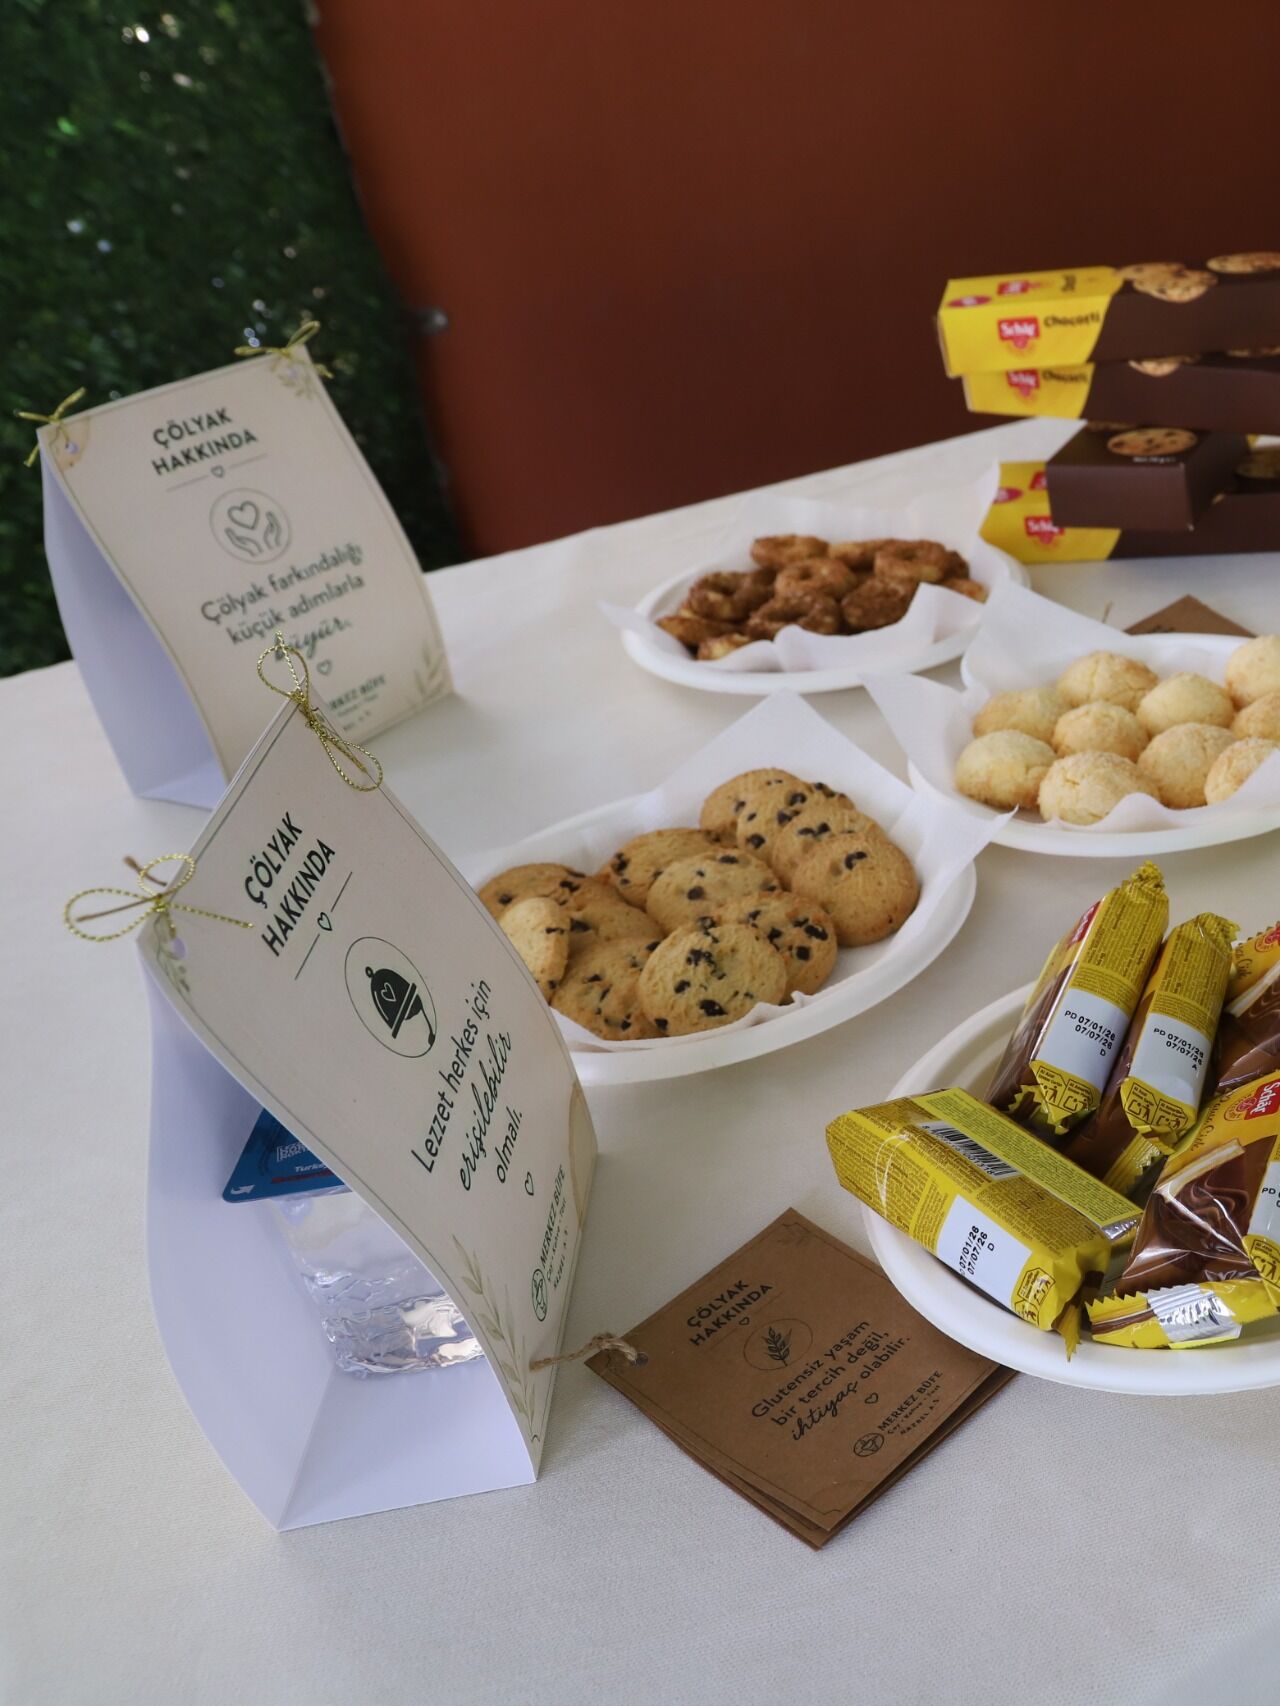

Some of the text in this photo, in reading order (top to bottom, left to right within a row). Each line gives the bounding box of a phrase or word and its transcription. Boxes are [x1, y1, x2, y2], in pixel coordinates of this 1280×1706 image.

[152, 429, 258, 476] HAKKINDA
[153, 408, 232, 450] ÇÖLYAK
[201, 582, 269, 625] Çölyak
[226, 574, 365, 645] küçük adımlarla
[245, 811, 303, 909] ÇÖLYAK
[261, 838, 336, 957] HAKKINDA
[1064, 1010, 1078, 1020] PD
[1153, 1027, 1166, 1036] PD
[411, 979, 491, 1173] Lezzet herkes için
[1250, 1081, 1280, 1115] Schär
[459, 1032, 511, 1191] erişilebilir
[495, 1106, 523, 1184] olmalı.
[540, 1165, 566, 1269] MERKEZ BÜFE
[1262, 1187, 1276, 1195] PD
[959, 1225, 980, 1269] 07/01/26
[967, 1231, 988, 1275] 07/07/26
[686, 1279, 749, 1328] ÇÖLYAK
[689, 1284, 774, 1346] HAKKINDA
[751, 1321, 870, 1418] Glutensiz yaşam
[770, 1331, 889, 1426] bir tercih değil,
[792, 1337, 911, 1441] ihtiyaç olabilir.
[877, 1370, 943, 1431] MERKEZ BÜFE
